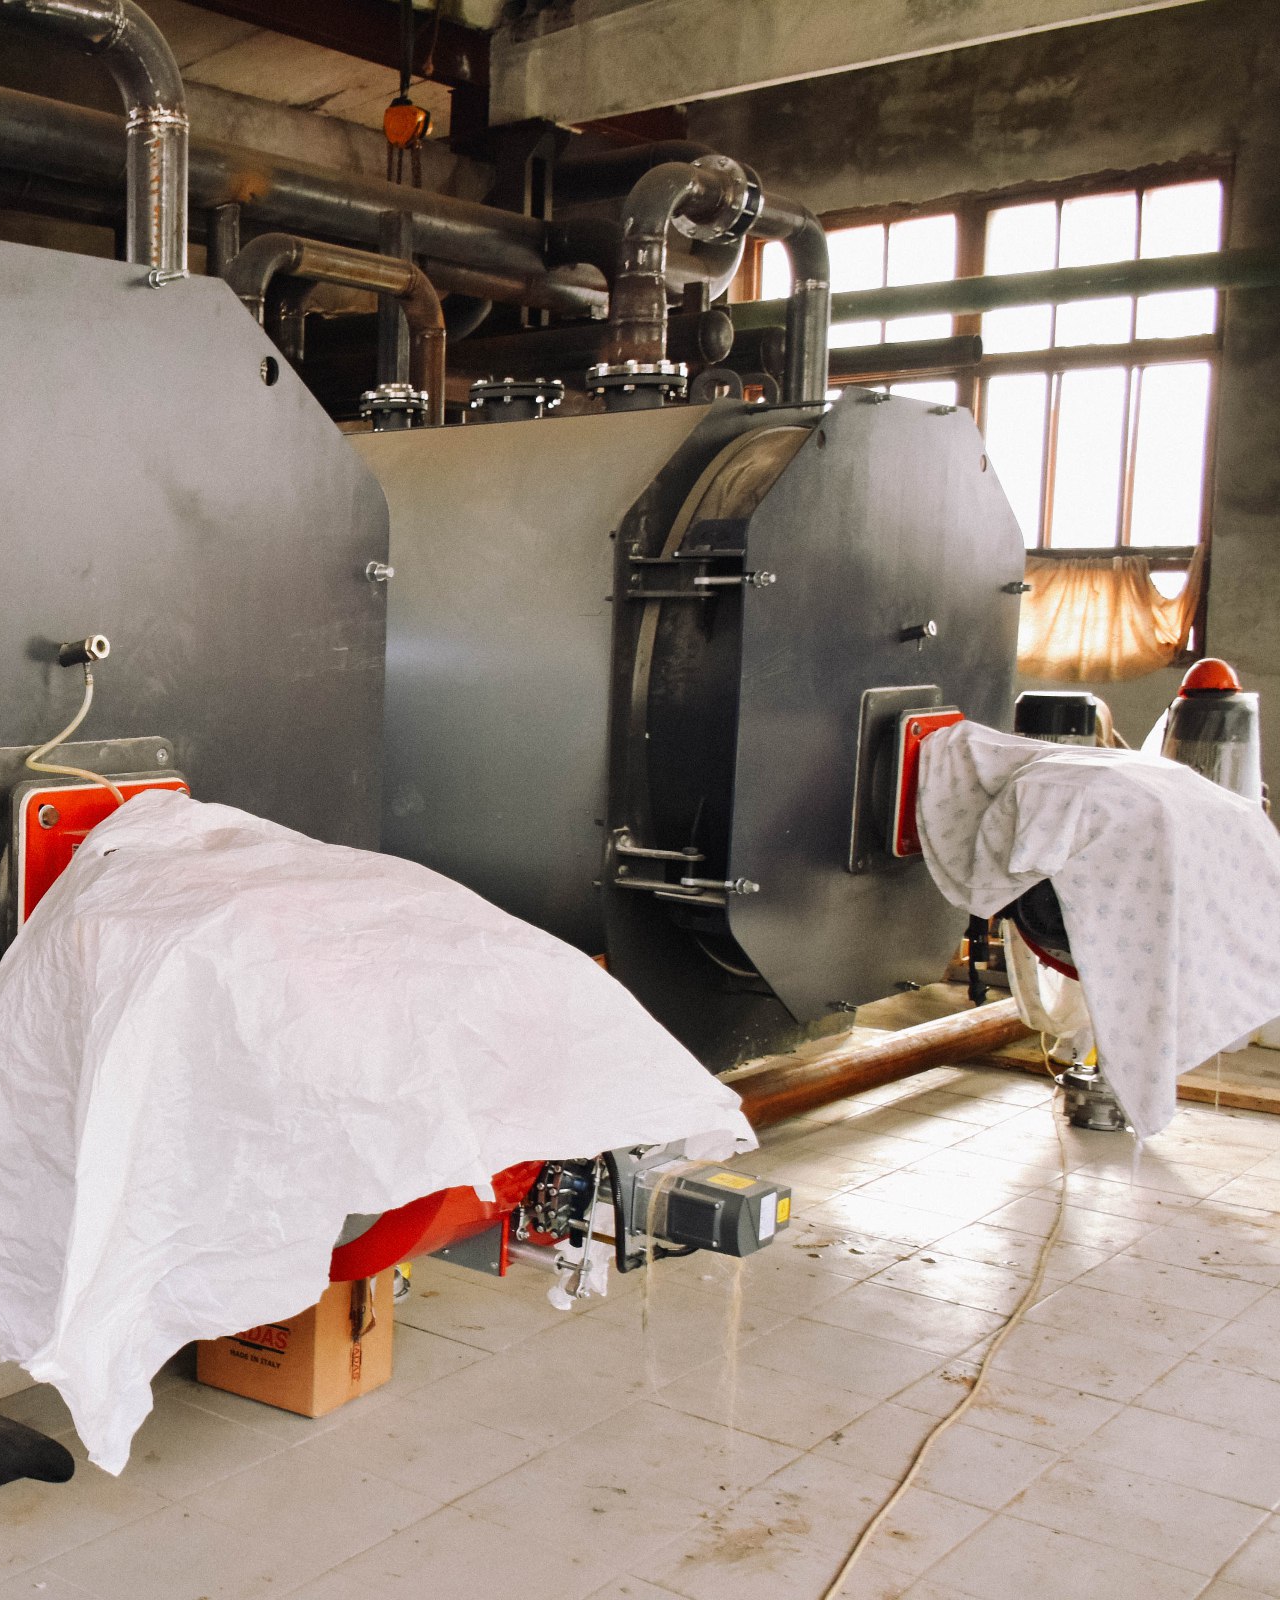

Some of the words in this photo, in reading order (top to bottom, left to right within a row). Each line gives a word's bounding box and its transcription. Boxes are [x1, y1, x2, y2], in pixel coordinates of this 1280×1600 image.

[230, 1349, 249, 1360] MADE
[250, 1354, 259, 1363] IN
[260, 1358, 281, 1369] ITALY
